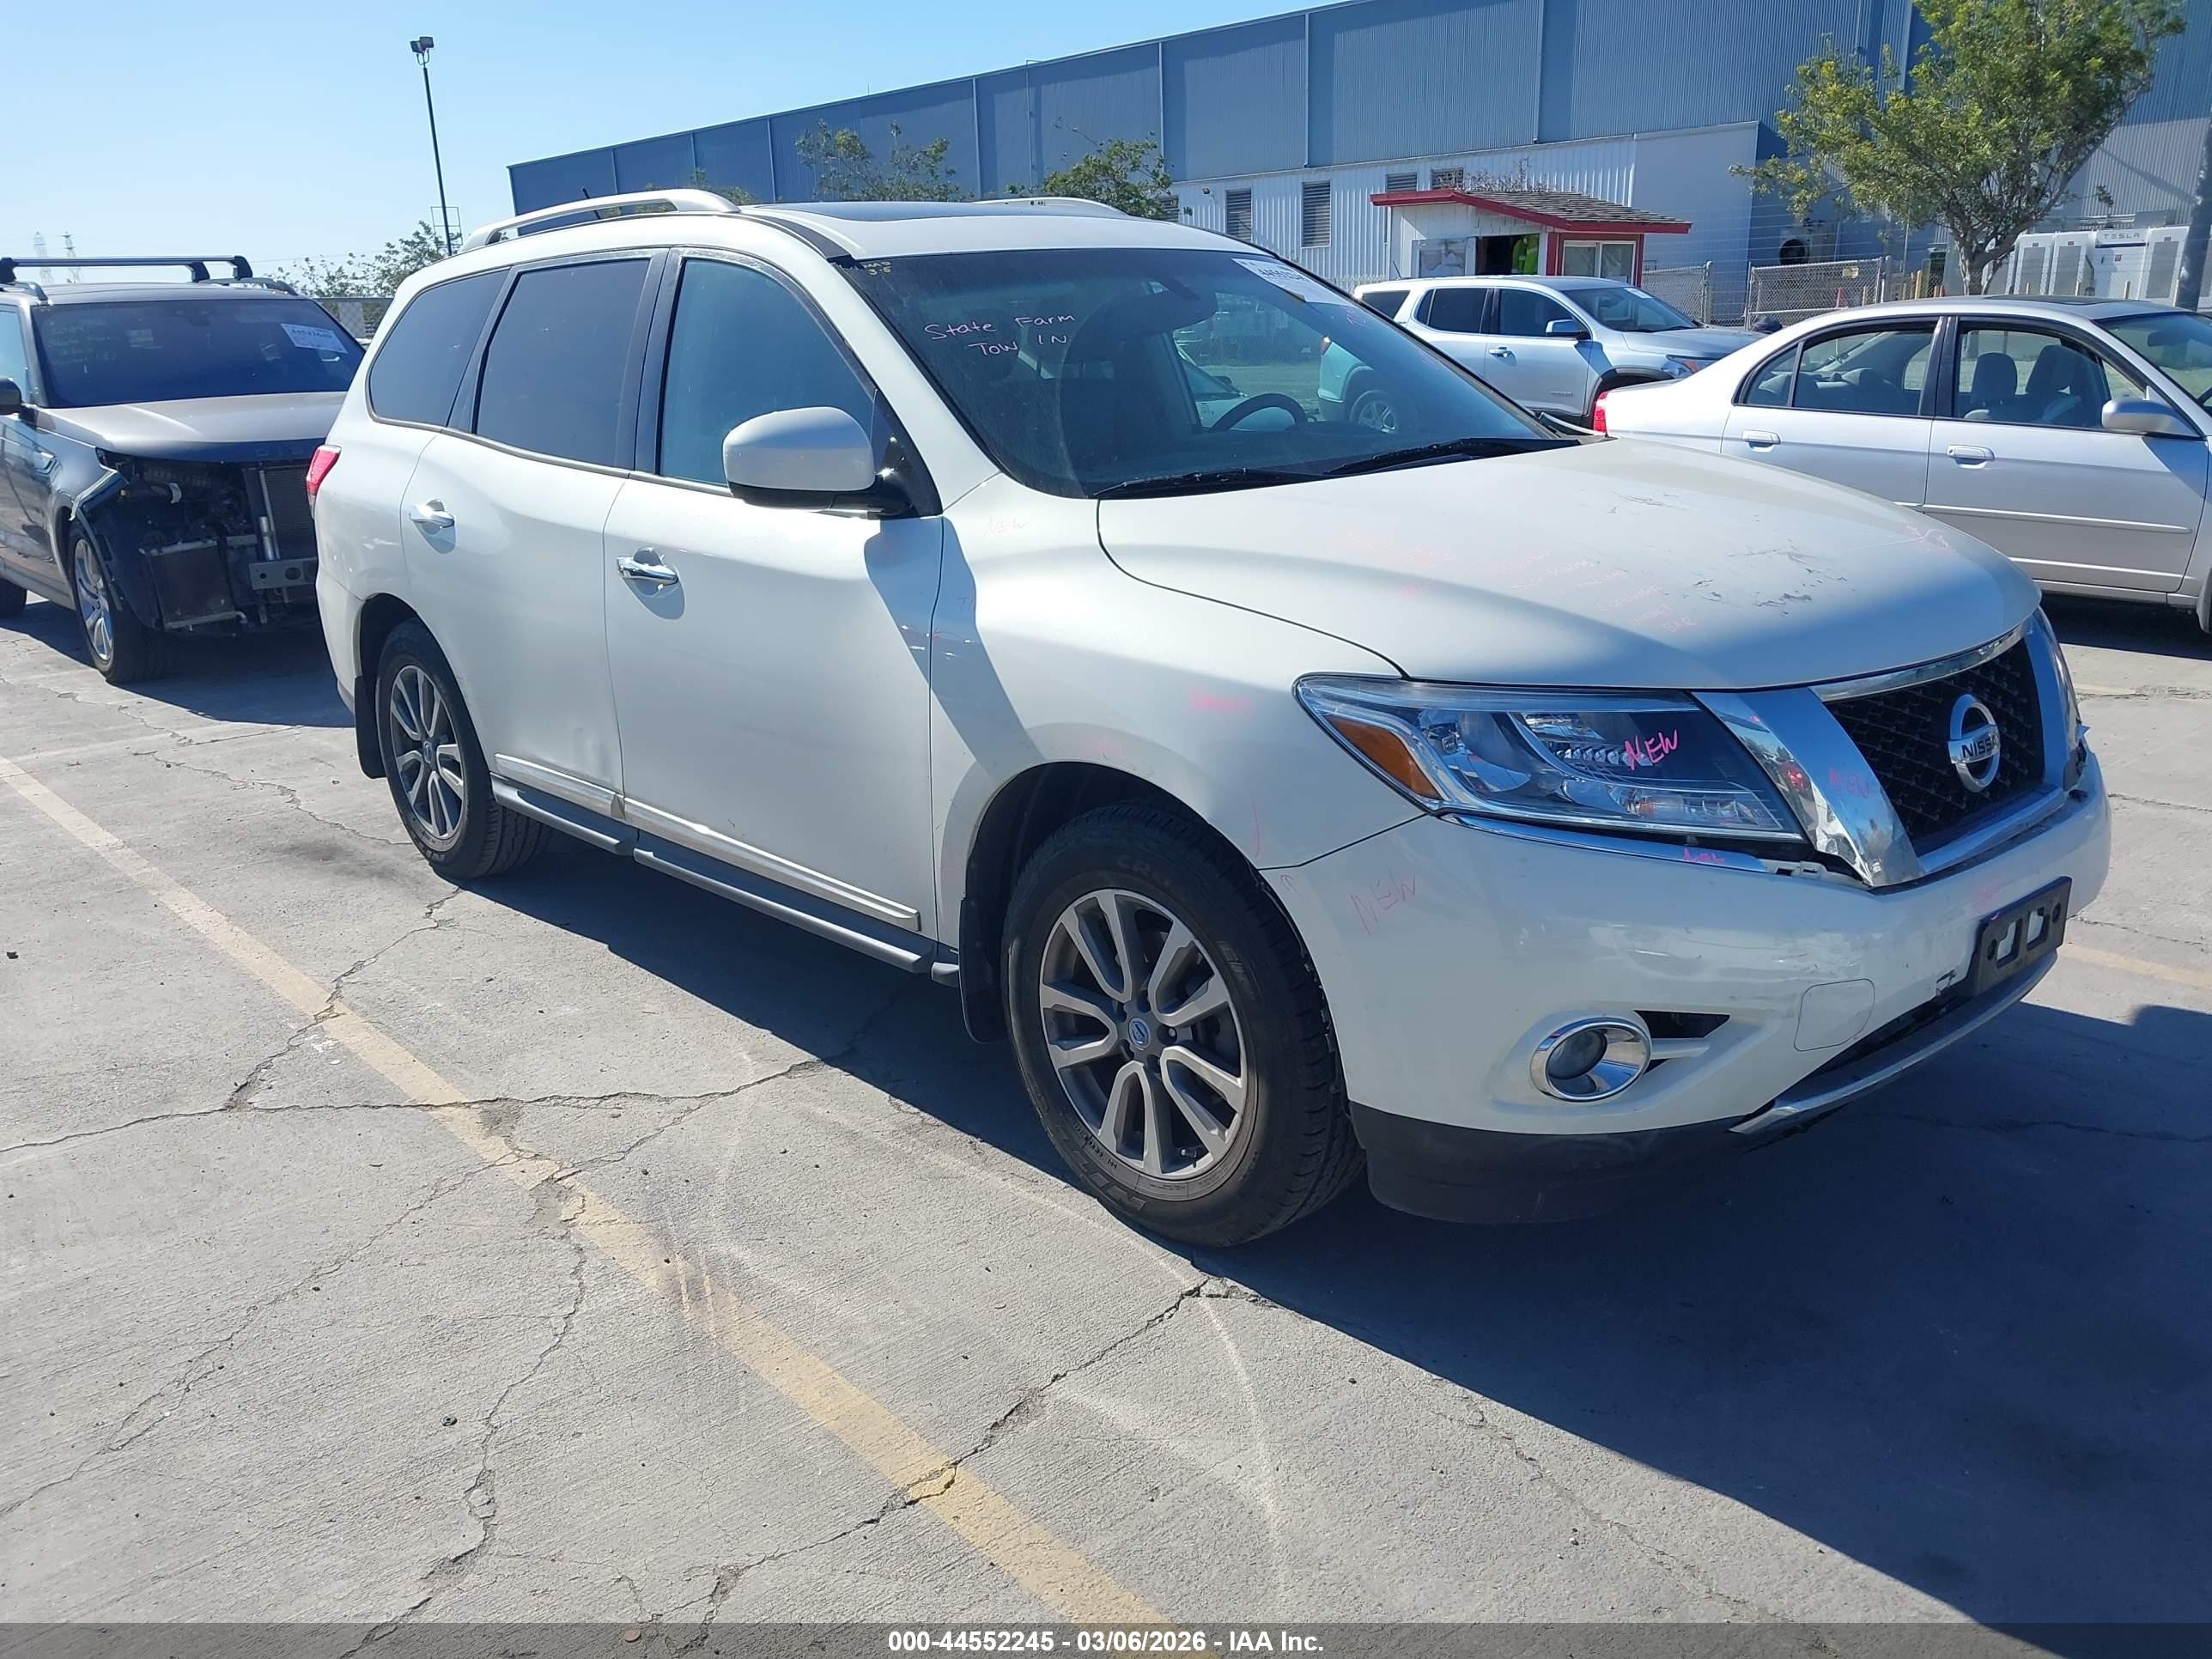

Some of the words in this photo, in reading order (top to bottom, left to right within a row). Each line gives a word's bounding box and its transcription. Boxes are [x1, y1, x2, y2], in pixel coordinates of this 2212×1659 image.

[924, 321, 997, 340] State
[1014, 314, 1076, 328] Farm
[1037, 334, 1067, 345] IN
[1624, 728, 1678, 771] NEW
[1961, 731, 2000, 758] NISSA
[1350, 869, 1416, 935] NEW
